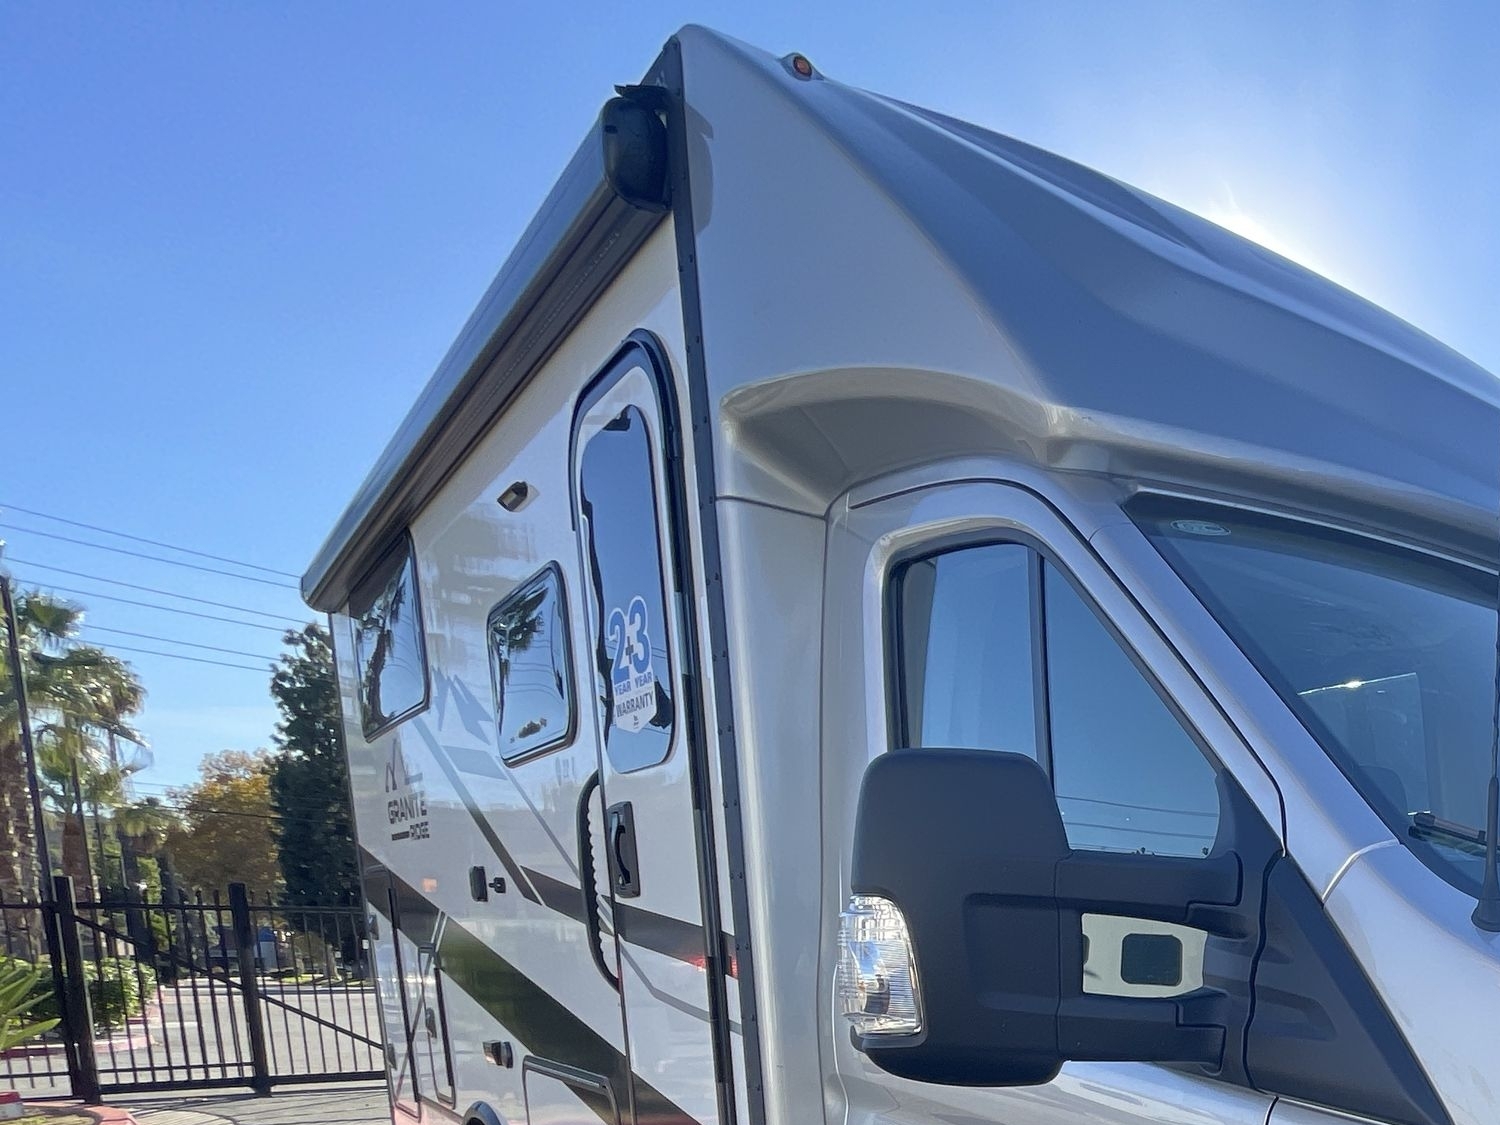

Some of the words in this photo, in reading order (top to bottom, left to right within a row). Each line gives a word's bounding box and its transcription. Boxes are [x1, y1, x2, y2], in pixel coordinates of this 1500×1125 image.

[614, 681, 632, 698] YEAR
[635, 671, 653, 688] YEAR
[615, 691, 654, 718] WARRANTY
